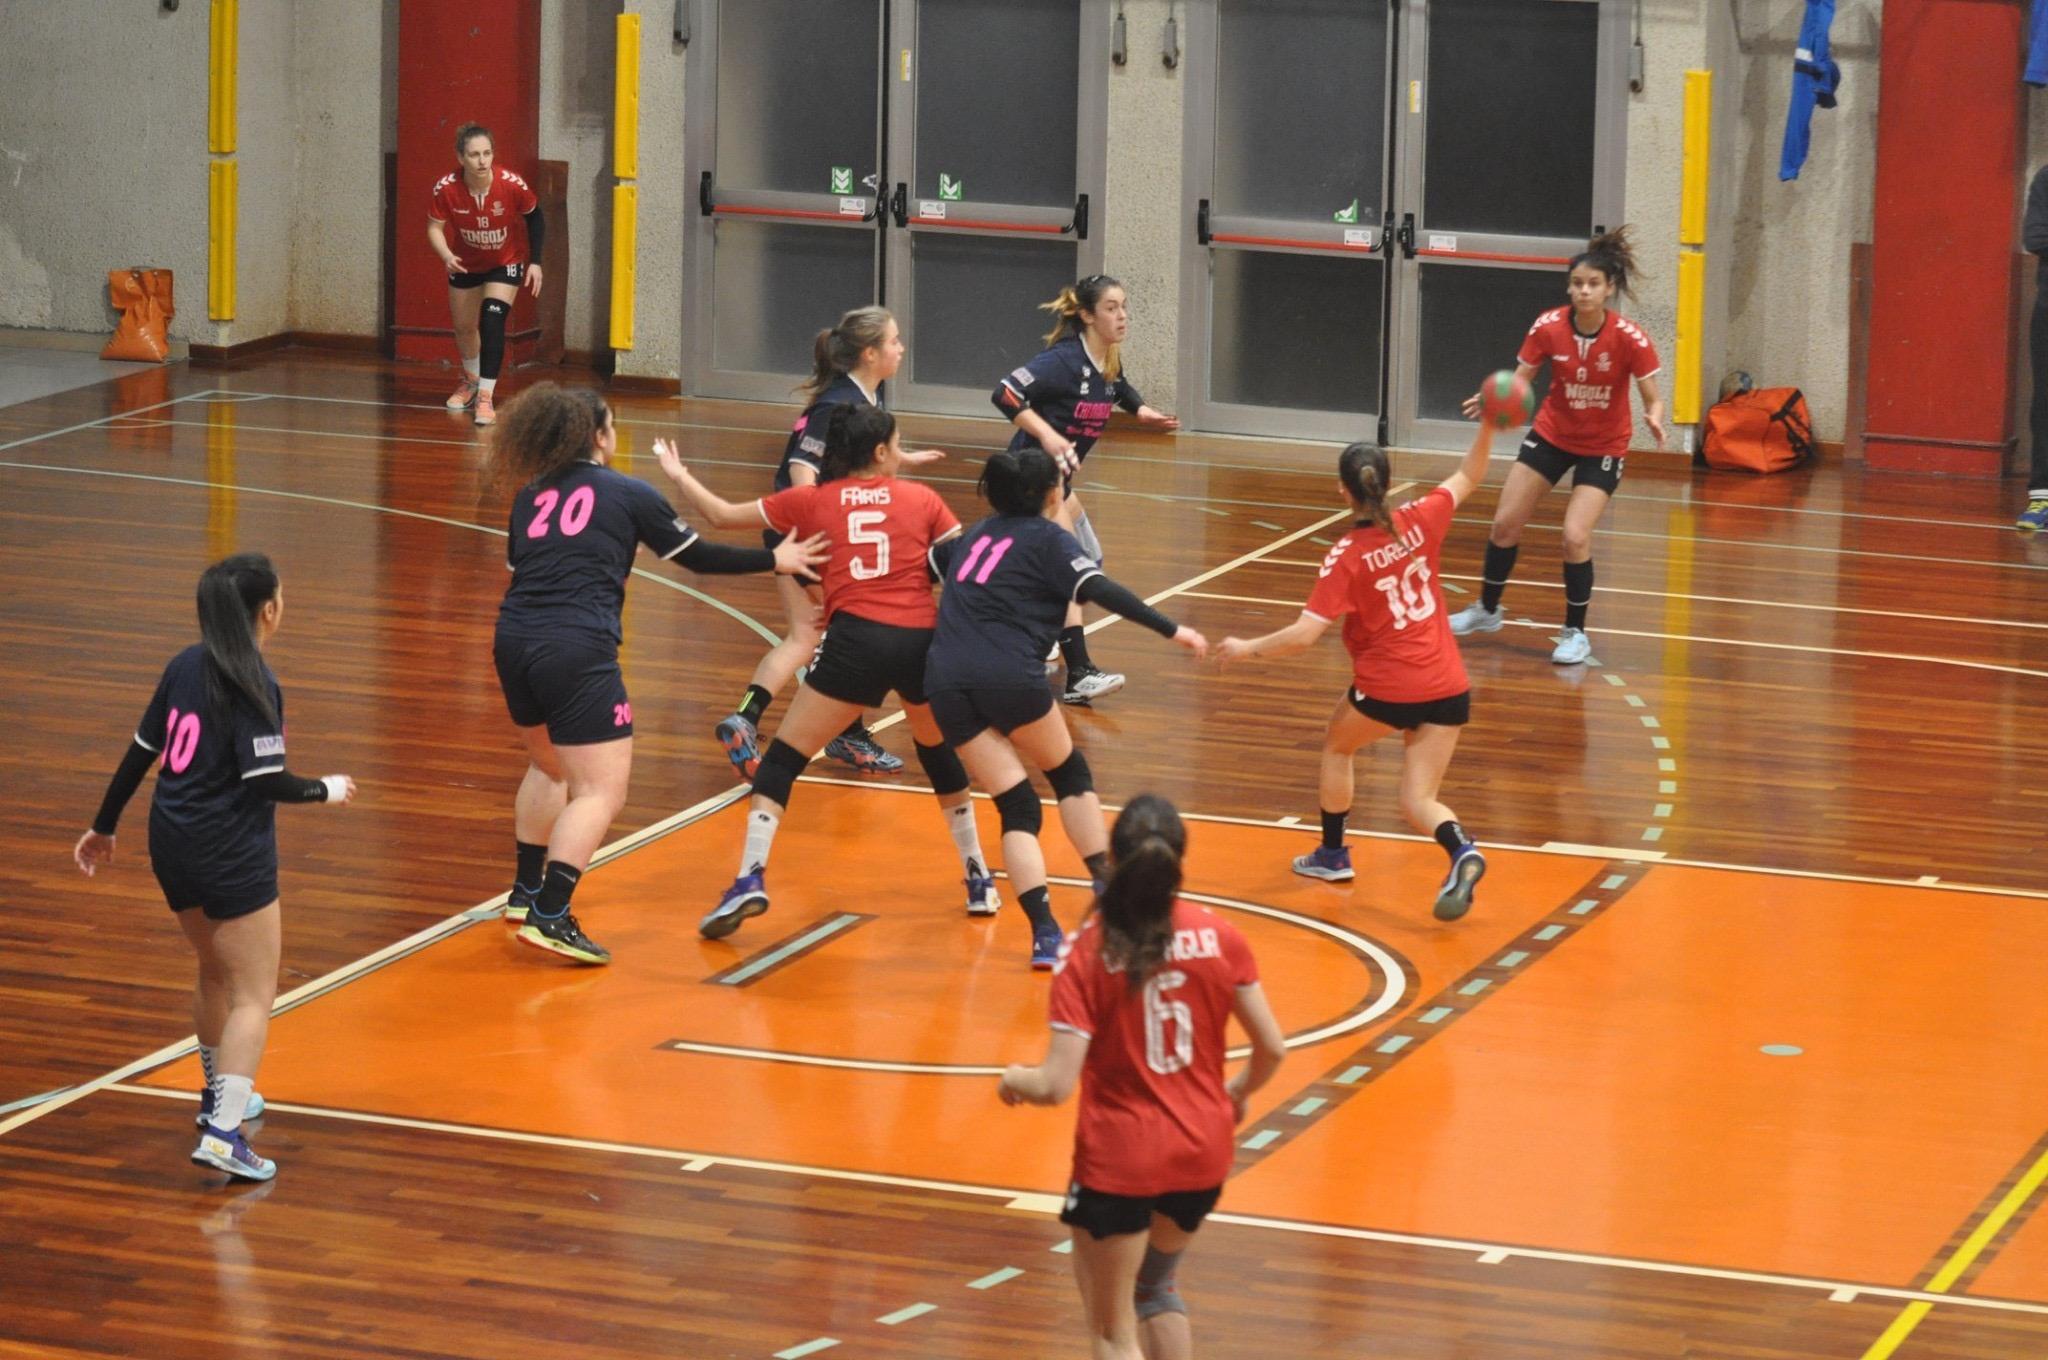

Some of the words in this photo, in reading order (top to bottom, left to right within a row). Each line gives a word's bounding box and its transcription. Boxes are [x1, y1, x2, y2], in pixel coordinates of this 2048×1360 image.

[477, 216, 489, 228] 18
[506, 264, 517, 277] 18
[1601, 455, 1613, 472] 8
[527, 485, 595, 538] 20
[840, 485, 891, 506] FARIS
[848, 511, 890, 580] 5
[956, 535, 1013, 584] 11
[1374, 556, 1437, 630] 10
[614, 703, 631, 726] 20
[160, 707, 200, 775] 10
[1144, 969, 1194, 1075] 6
